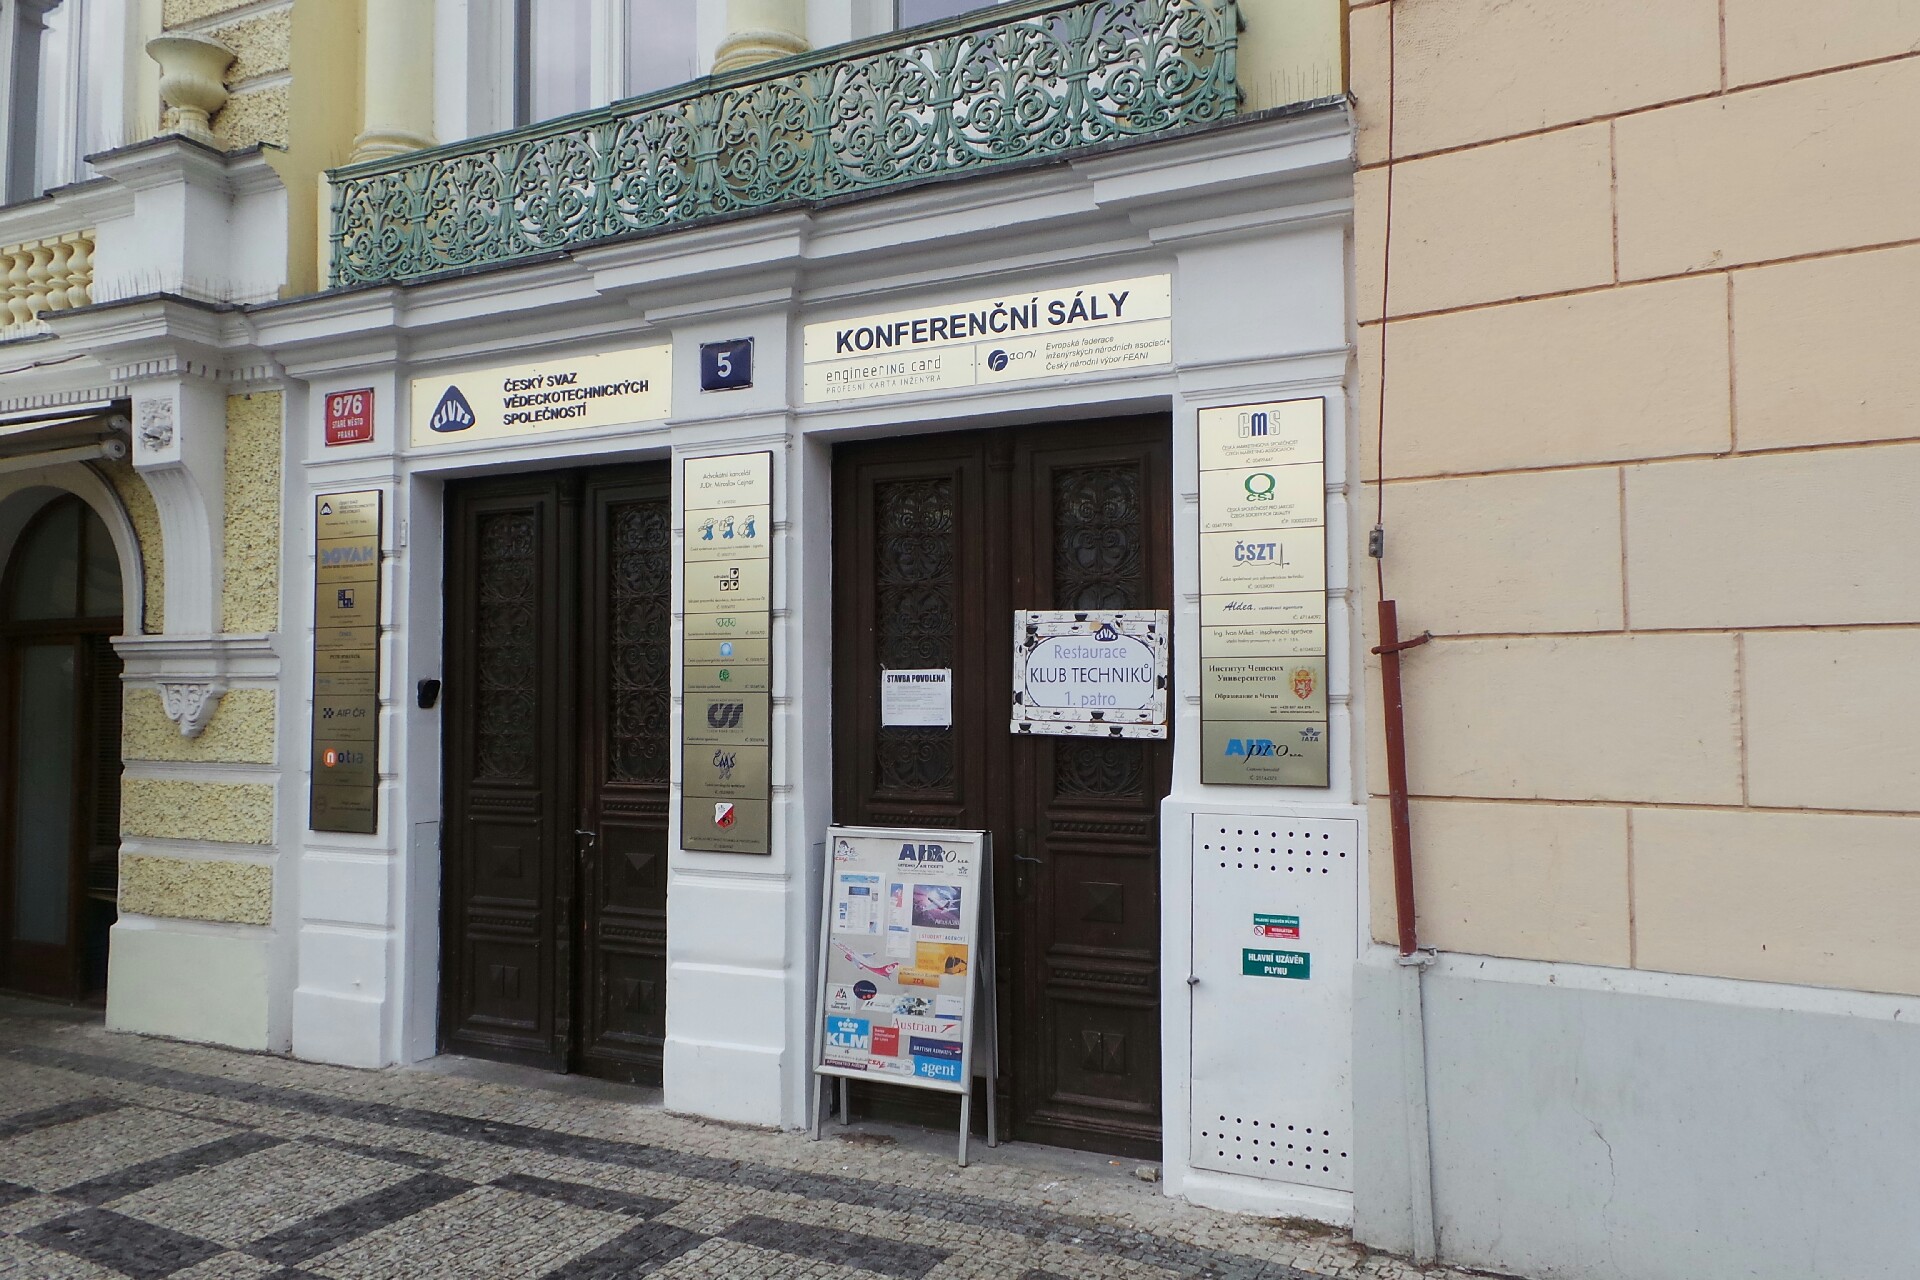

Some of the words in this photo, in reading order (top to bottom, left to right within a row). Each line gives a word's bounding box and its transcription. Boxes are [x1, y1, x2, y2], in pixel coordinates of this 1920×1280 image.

[836, 297, 1039, 354] KONFERENČNÍ
[1047, 290, 1130, 326] SÁLY
[717, 351, 732, 378] 5
[911, 354, 942, 372] card
[1045, 359, 1069, 372] Český
[1099, 354, 1122, 366] výbor
[1122, 351, 1149, 363] FEANI
[503, 374, 544, 393] ČESKÝ
[546, 372, 578, 388] SVAZ
[868, 379, 897, 391] KARTA
[502, 379, 650, 410] VĚDECKOTECHNICKÝCH
[332, 394, 363, 417] 976
[502, 401, 587, 426] SPOLEČNOSTÍ
[331, 418, 347, 430] STARÉ
[347, 416, 364, 427] MĚSTO
[337, 430, 354, 440] PRAHA
[354, 429, 359, 438] 1
[1234, 540, 1277, 562] ČSZT
[1053, 644, 1127, 659] Restaurace
[1030, 667, 1067, 683] KLUB
[1071, 663, 1152, 683] TECHNIKŮ
[1208, 664, 1246, 675] Институт
[1247, 664, 1285, 673] Чешских
[886, 674, 911, 683] STAVBA
[911, 674, 946, 683] POVOLENA
[1217, 673, 1277, 684] Университетов
[1064, 691, 1076, 706] 1.
[1081, 691, 1117, 708] patro
[336, 708, 352, 718] AIP
[352, 707, 366, 718] ČR
[1248, 953, 1274, 963] HLAVNÍ
[1275, 953, 1304, 965] UZÁVĚR
[1264, 965, 1288, 976] PLYNU
[892, 1017, 937, 1034] Austrian
[826, 1032, 868, 1049] KLM
[913, 1045, 932, 1054] BRITISH
[921, 1062, 955, 1078] agent
